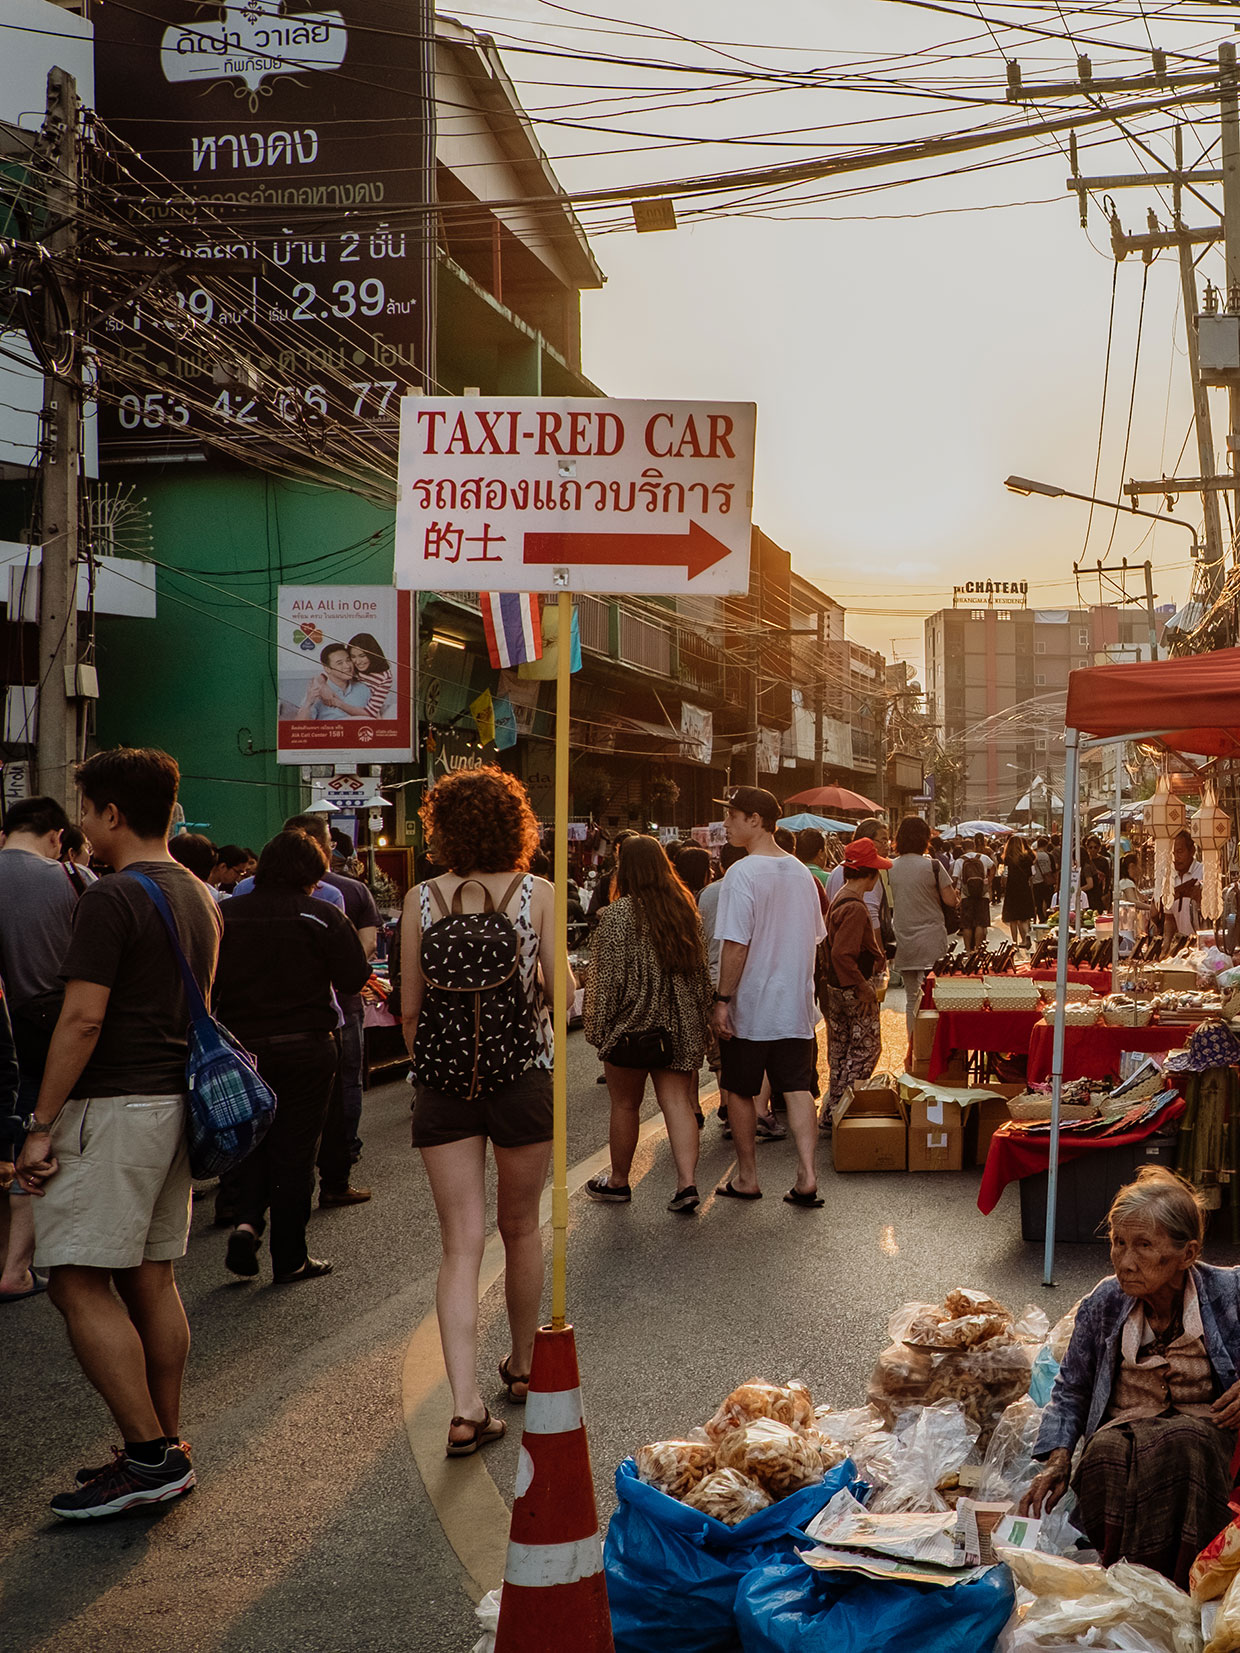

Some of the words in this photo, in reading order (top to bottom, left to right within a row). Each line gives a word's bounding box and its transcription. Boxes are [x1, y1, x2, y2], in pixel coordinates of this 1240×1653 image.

[191, 128, 319, 173] หางดง
[340, 231, 360, 262] 2
[292, 278, 386, 321] 2.39
[351, 381, 398, 416] 77
[417, 410, 625, 457] TAXI-RED
[644, 412, 736, 459] CAR
[412, 467, 736, 515] รถสองแถวบริการ
[423, 521, 507, 564] 的士
[292, 600, 314, 611] AIA
[317, 600, 335, 611] All
[338, 600, 350, 611] in
[353, 600, 377, 611] One
